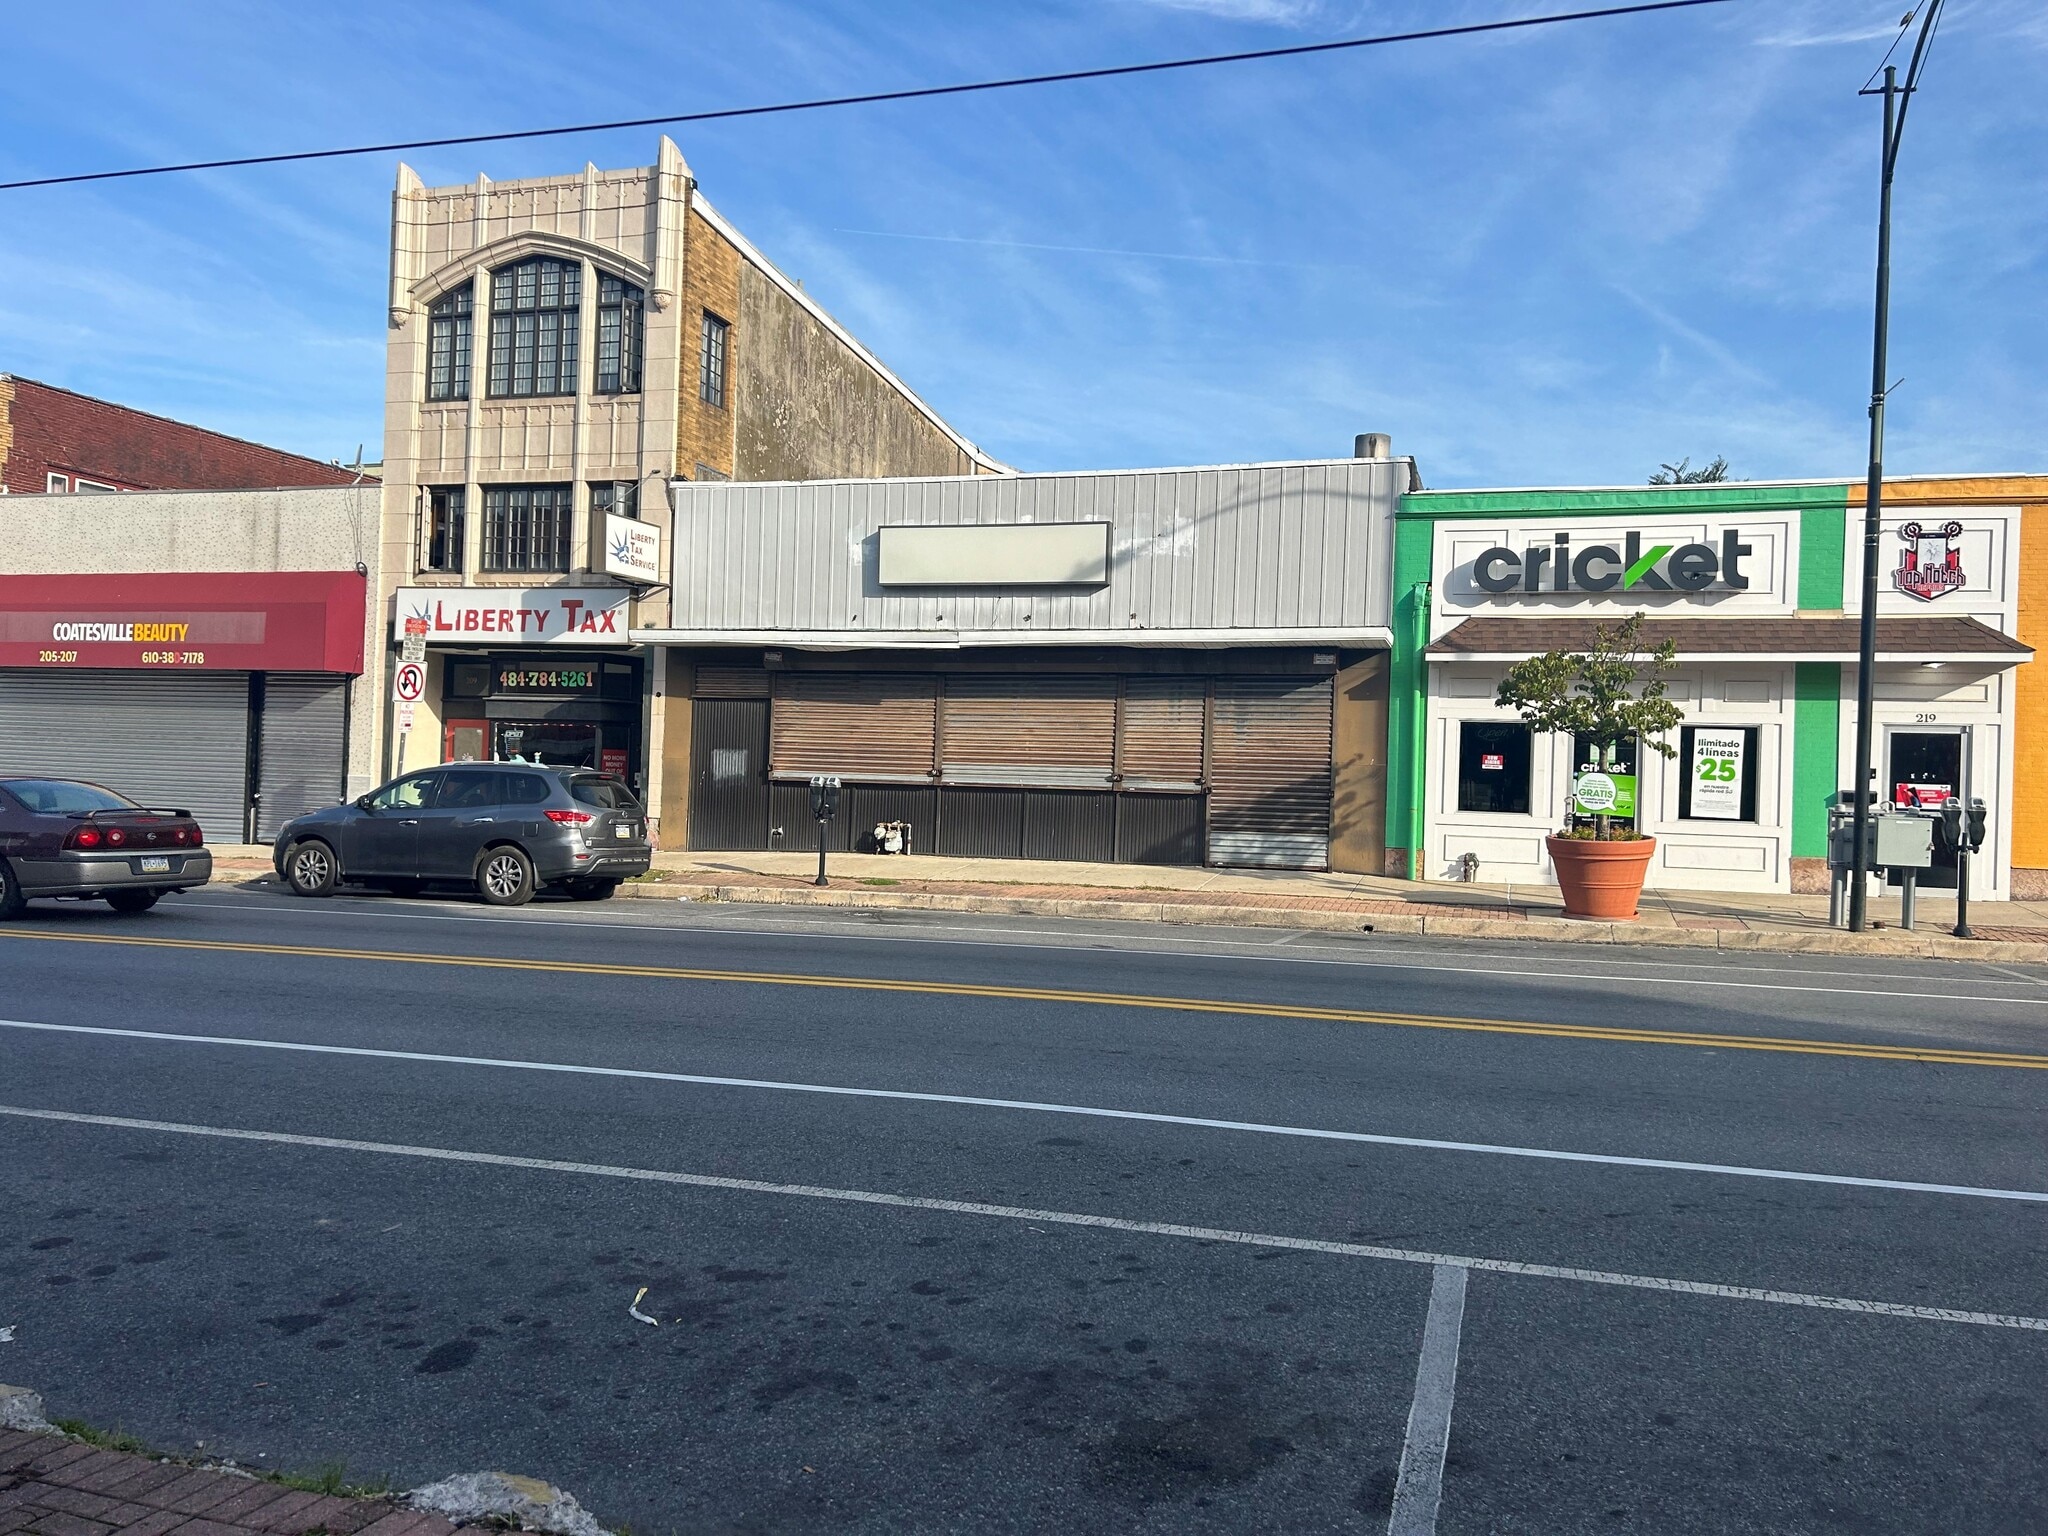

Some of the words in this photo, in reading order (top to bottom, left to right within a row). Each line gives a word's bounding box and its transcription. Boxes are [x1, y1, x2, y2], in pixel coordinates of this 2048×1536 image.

[630, 529, 655, 546] LIBERTY
[630, 542, 643, 555] TAX
[630, 555, 656, 571] SERVICE
[1473, 529, 1752, 592] cricket
[1897, 569, 1921, 589] Top
[1924, 563, 1965, 585] Notch
[435, 600, 550, 632] LIBERTY
[561, 599, 616, 633] TAX
[39, 650, 78, 663] 205-207
[1915, 713, 1936, 723] 219
[1698, 738, 1740, 748] Ilimitado
[1697, 747, 1704, 756] 4
[1580, 762, 1627, 773] criket
[1695, 758, 1736, 782] $25
[1578, 788, 1614, 799] GRATIS
